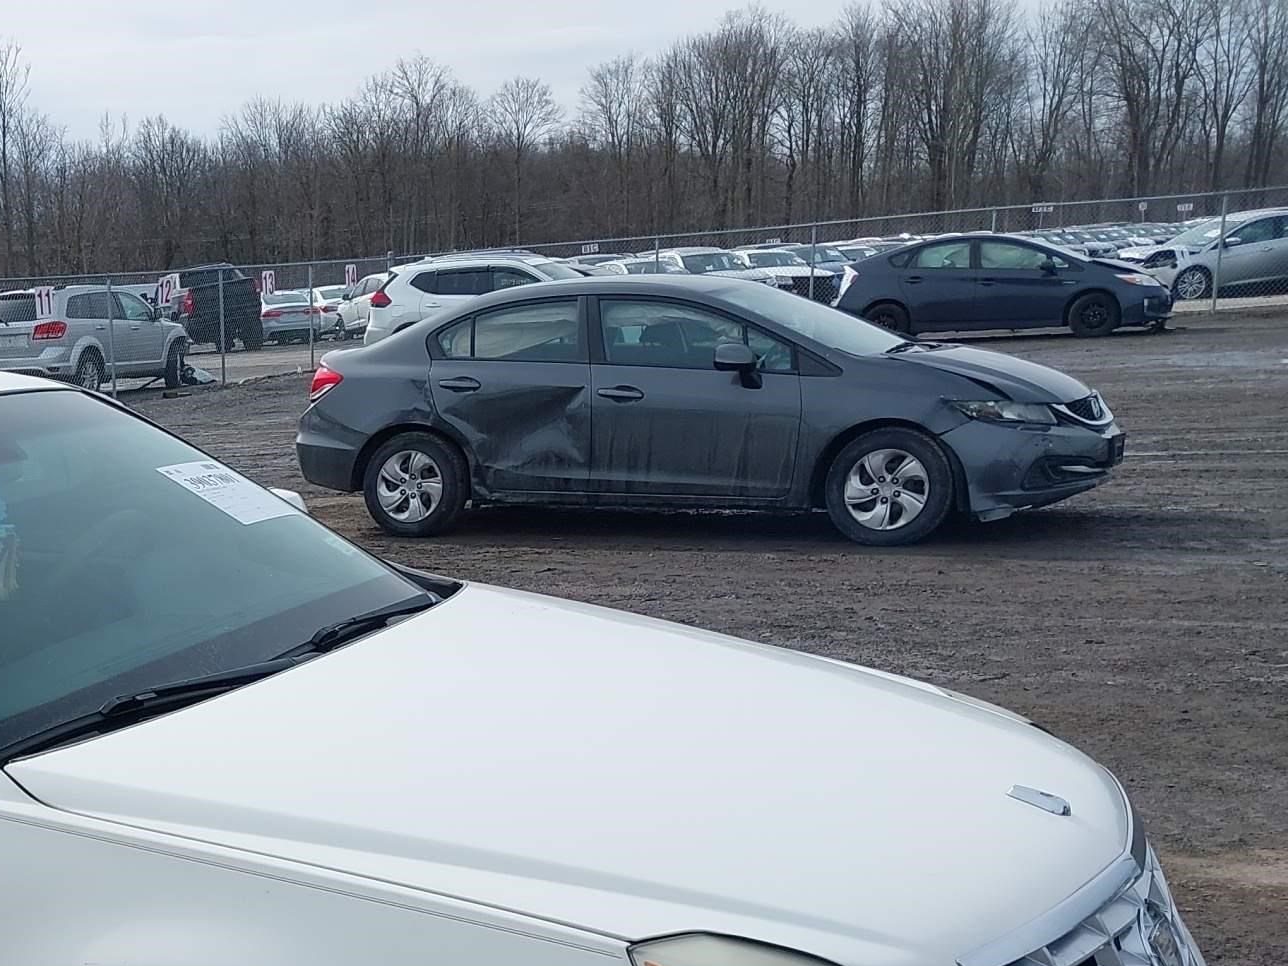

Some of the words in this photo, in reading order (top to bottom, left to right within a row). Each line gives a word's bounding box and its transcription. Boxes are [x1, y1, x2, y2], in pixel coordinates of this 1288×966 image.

[263, 272, 274, 295] 13
[346, 265, 356, 286] 14
[36, 288, 52, 315] 11
[159, 279, 171, 304] 12
